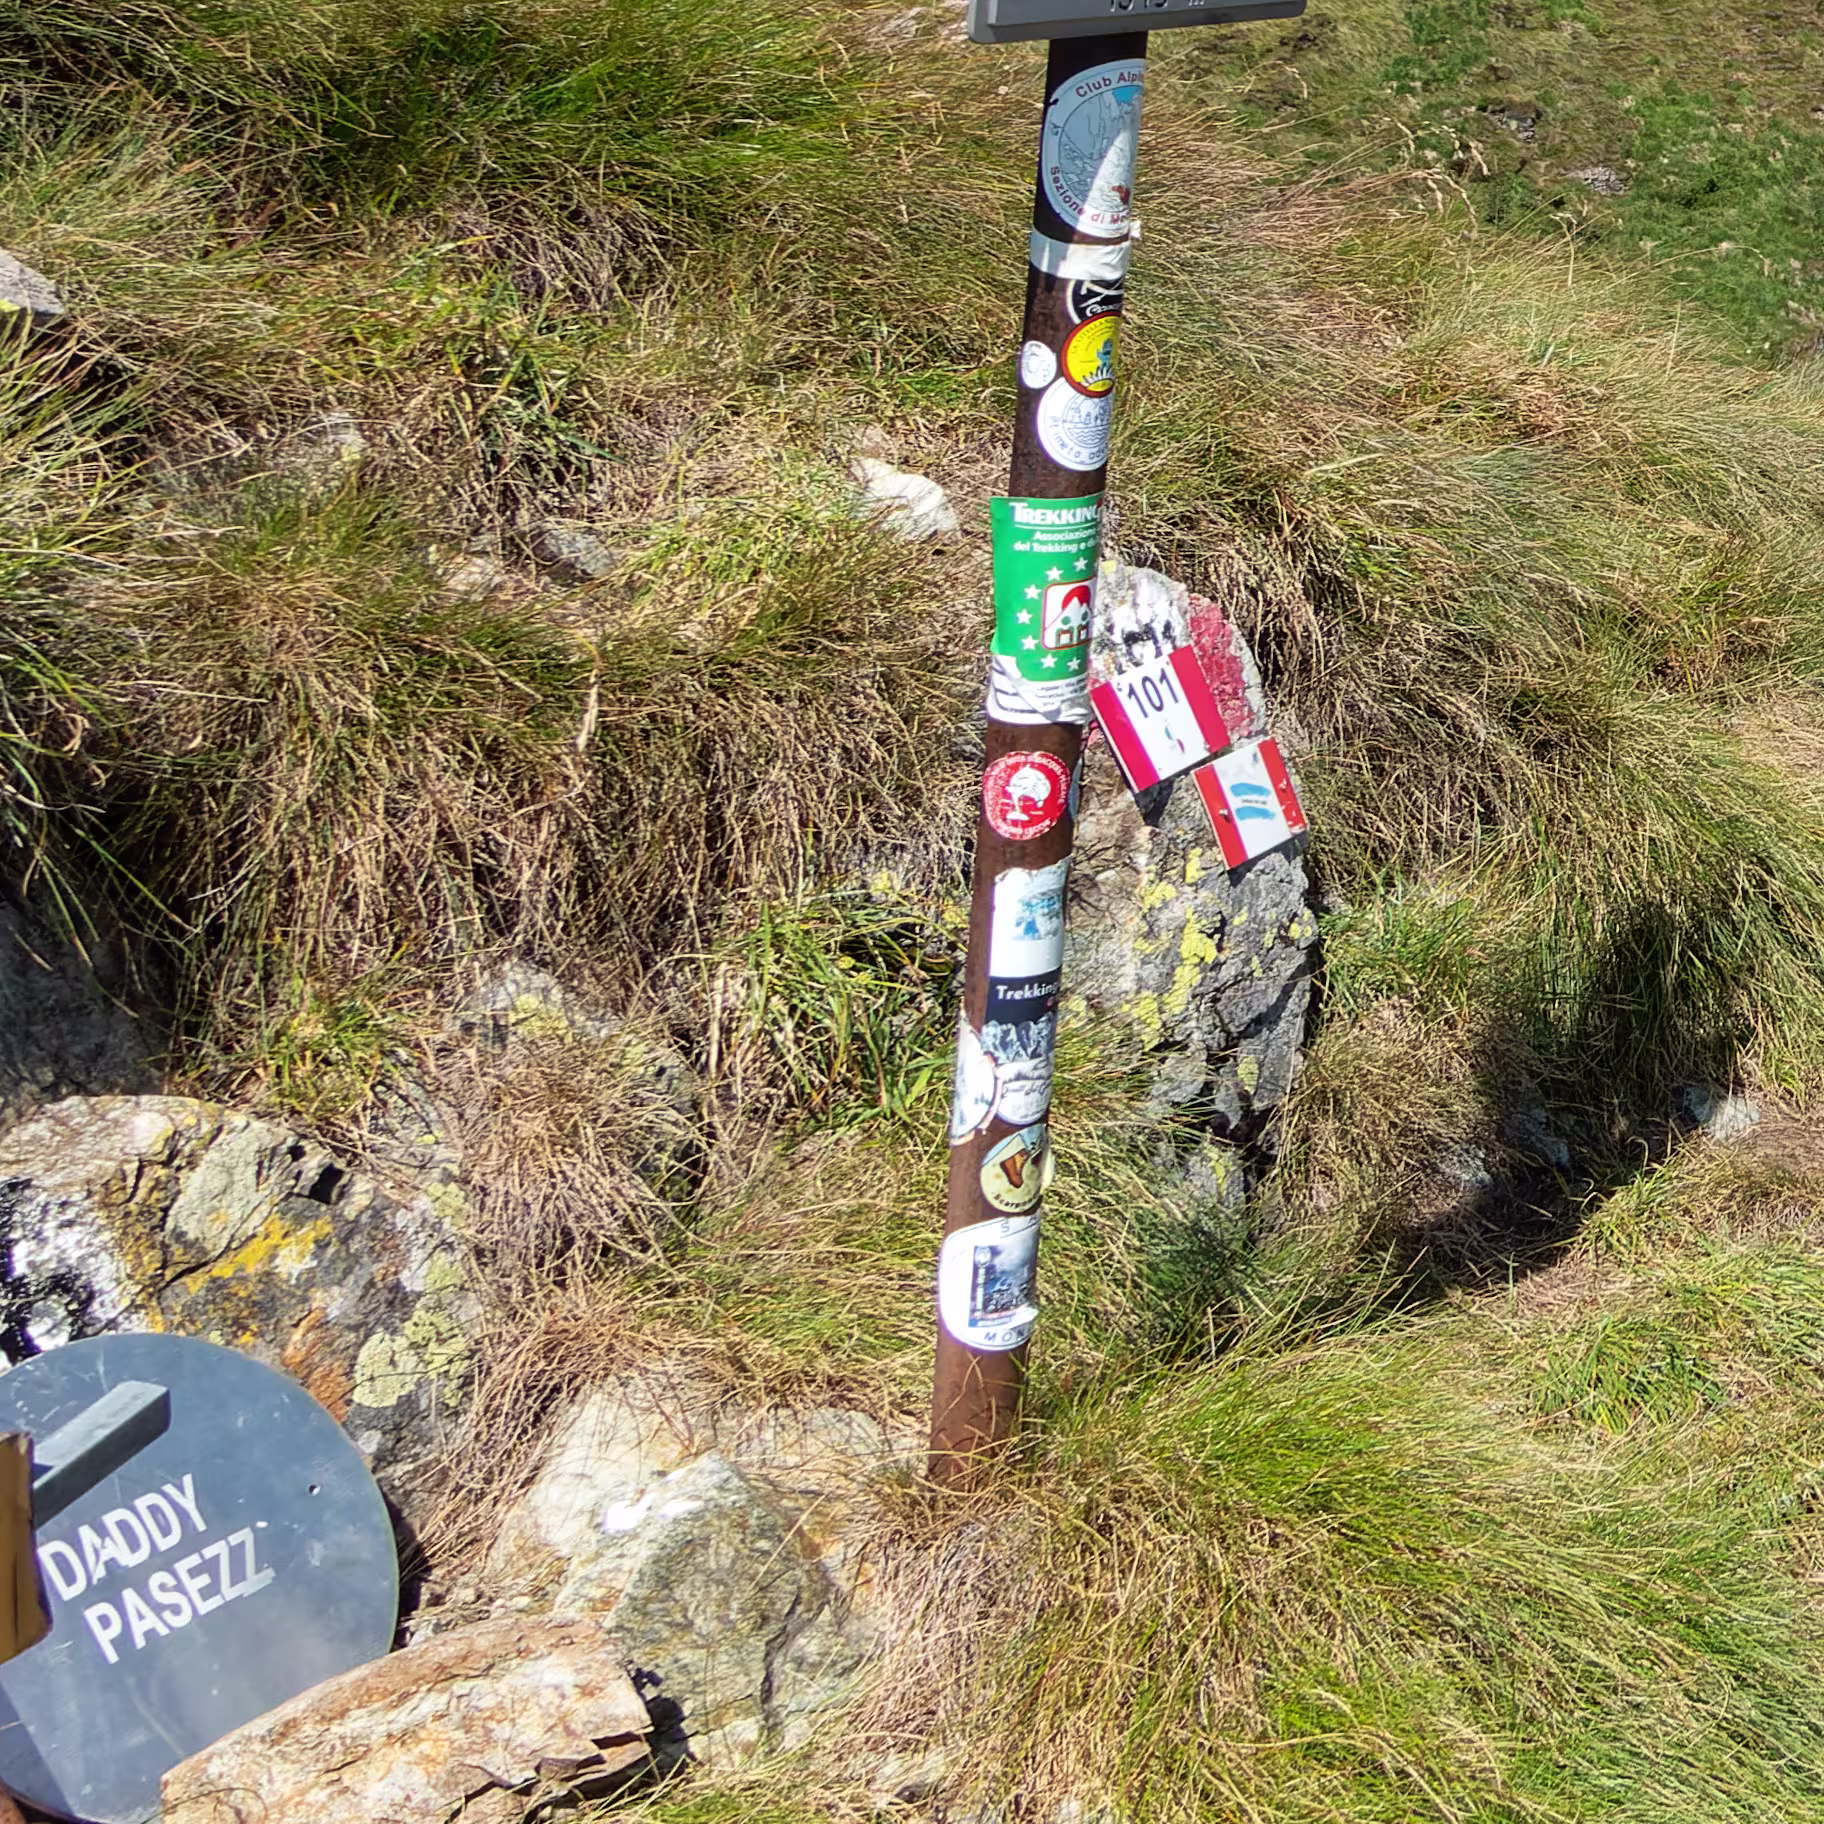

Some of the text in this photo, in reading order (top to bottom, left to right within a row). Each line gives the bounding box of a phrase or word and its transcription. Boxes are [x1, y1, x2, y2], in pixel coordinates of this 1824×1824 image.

[1075, 76, 1112, 98] Club
[1050, 166, 1085, 217] Sezione
[1090, 213, 1105, 224] di
[1127, 667, 1179, 719] 101
[38, 1473, 208, 1602] DADDY
[83, 1526, 277, 1665] PASEZZ
